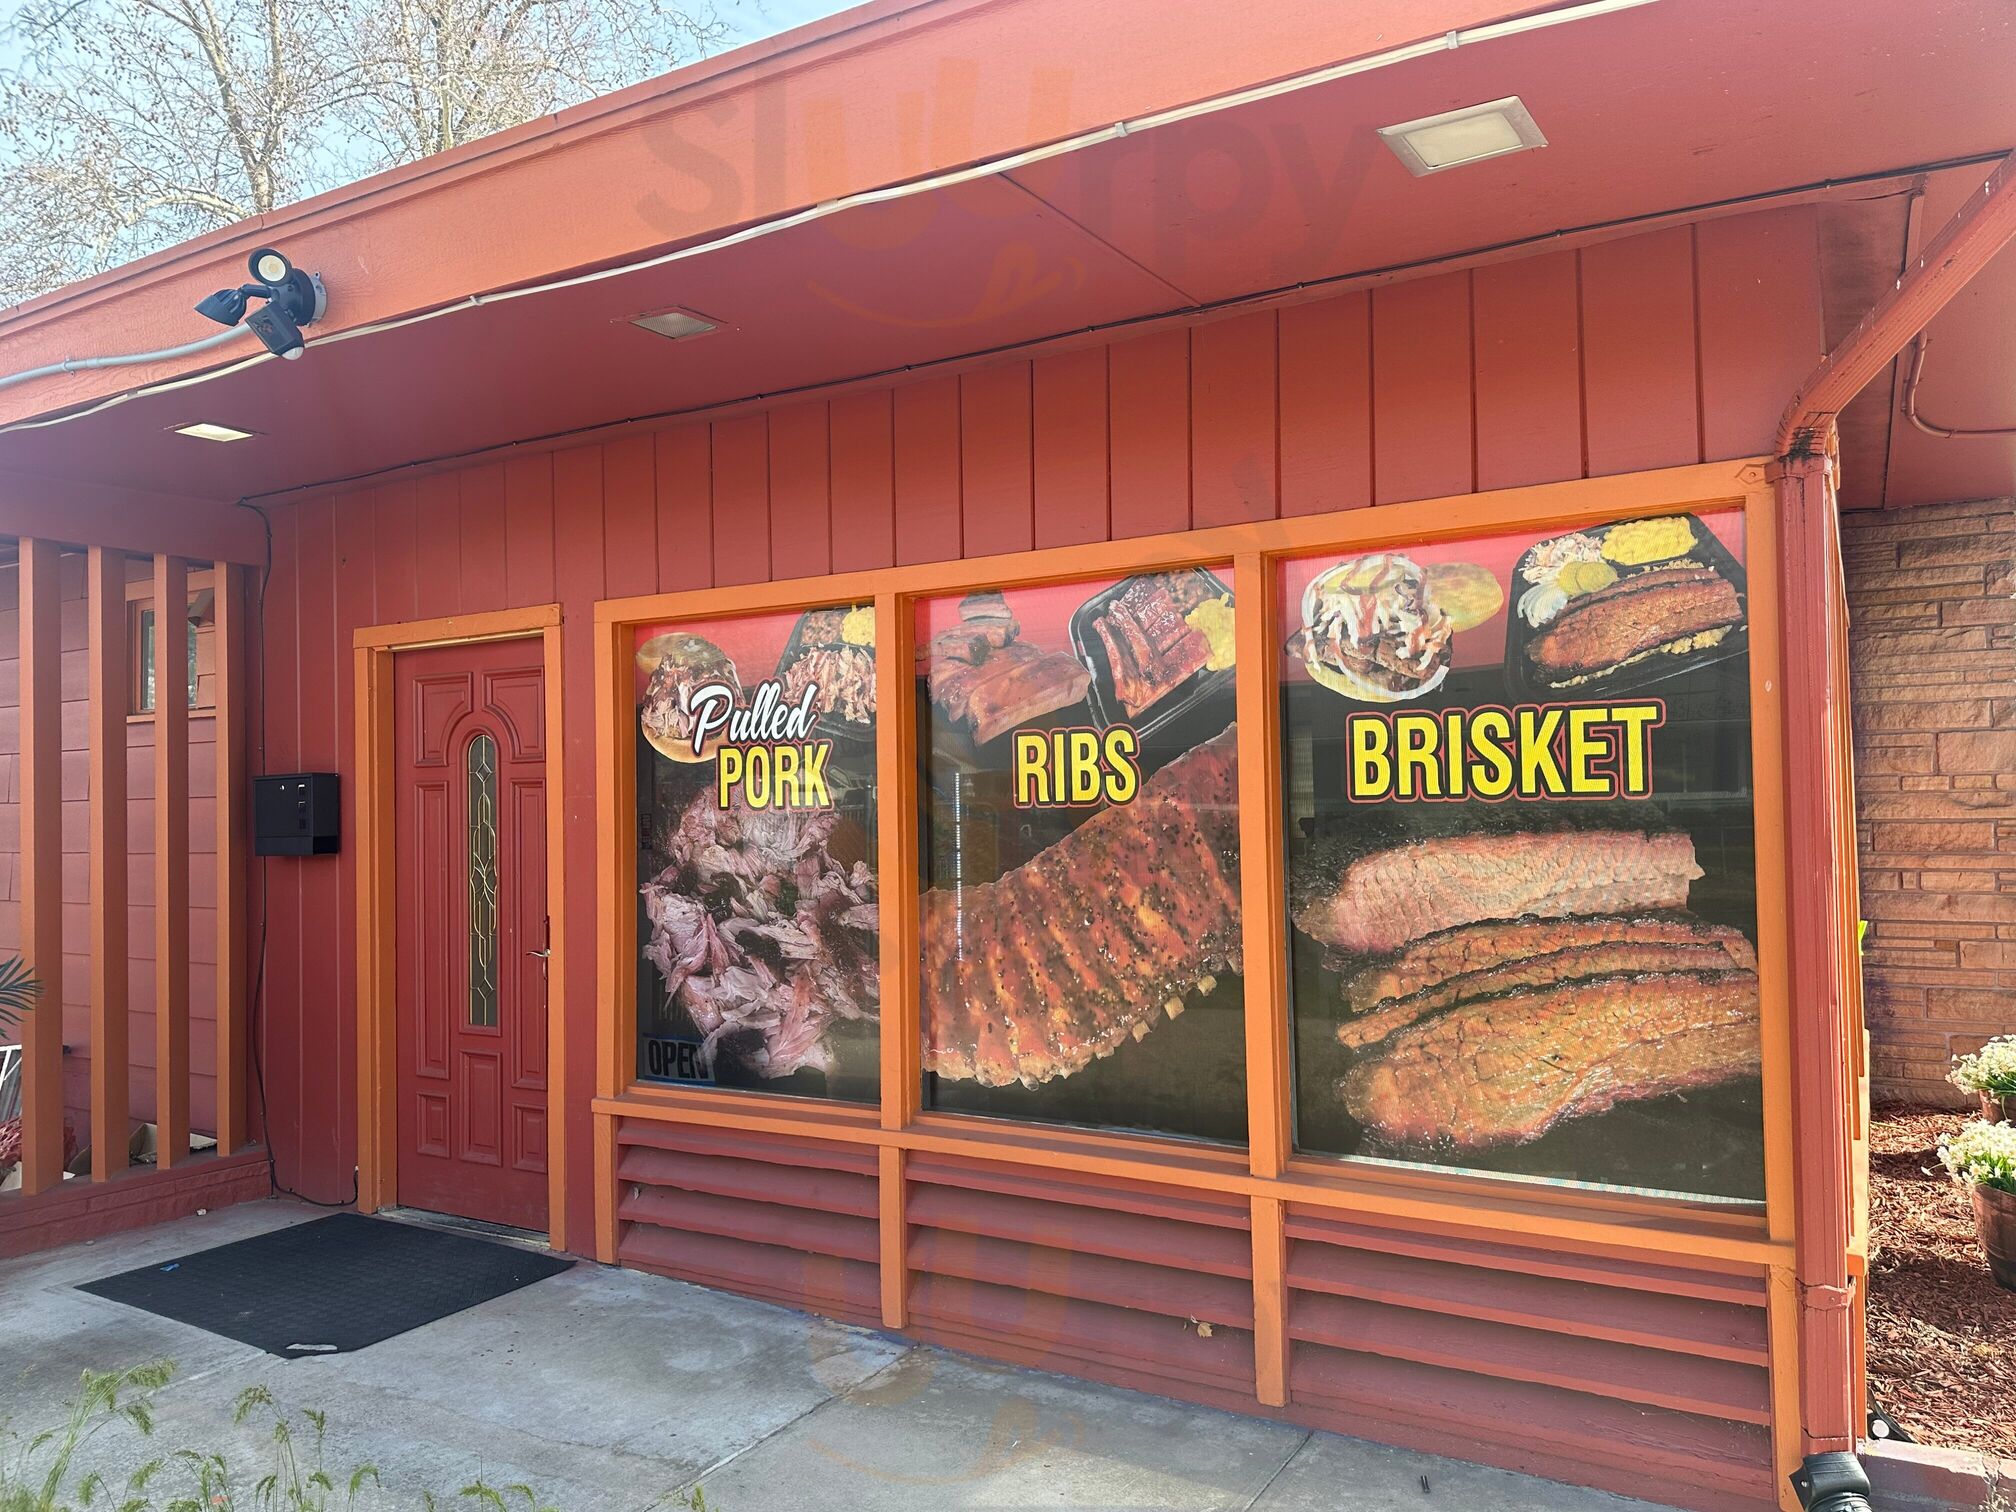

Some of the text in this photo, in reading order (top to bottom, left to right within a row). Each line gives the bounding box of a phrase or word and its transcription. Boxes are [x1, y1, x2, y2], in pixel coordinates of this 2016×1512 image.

[688, 680, 818, 754] Pulled
[1351, 705, 1659, 797] BRISKET
[718, 743, 831, 809] PORK
[1015, 727, 1138, 804] RIBS
